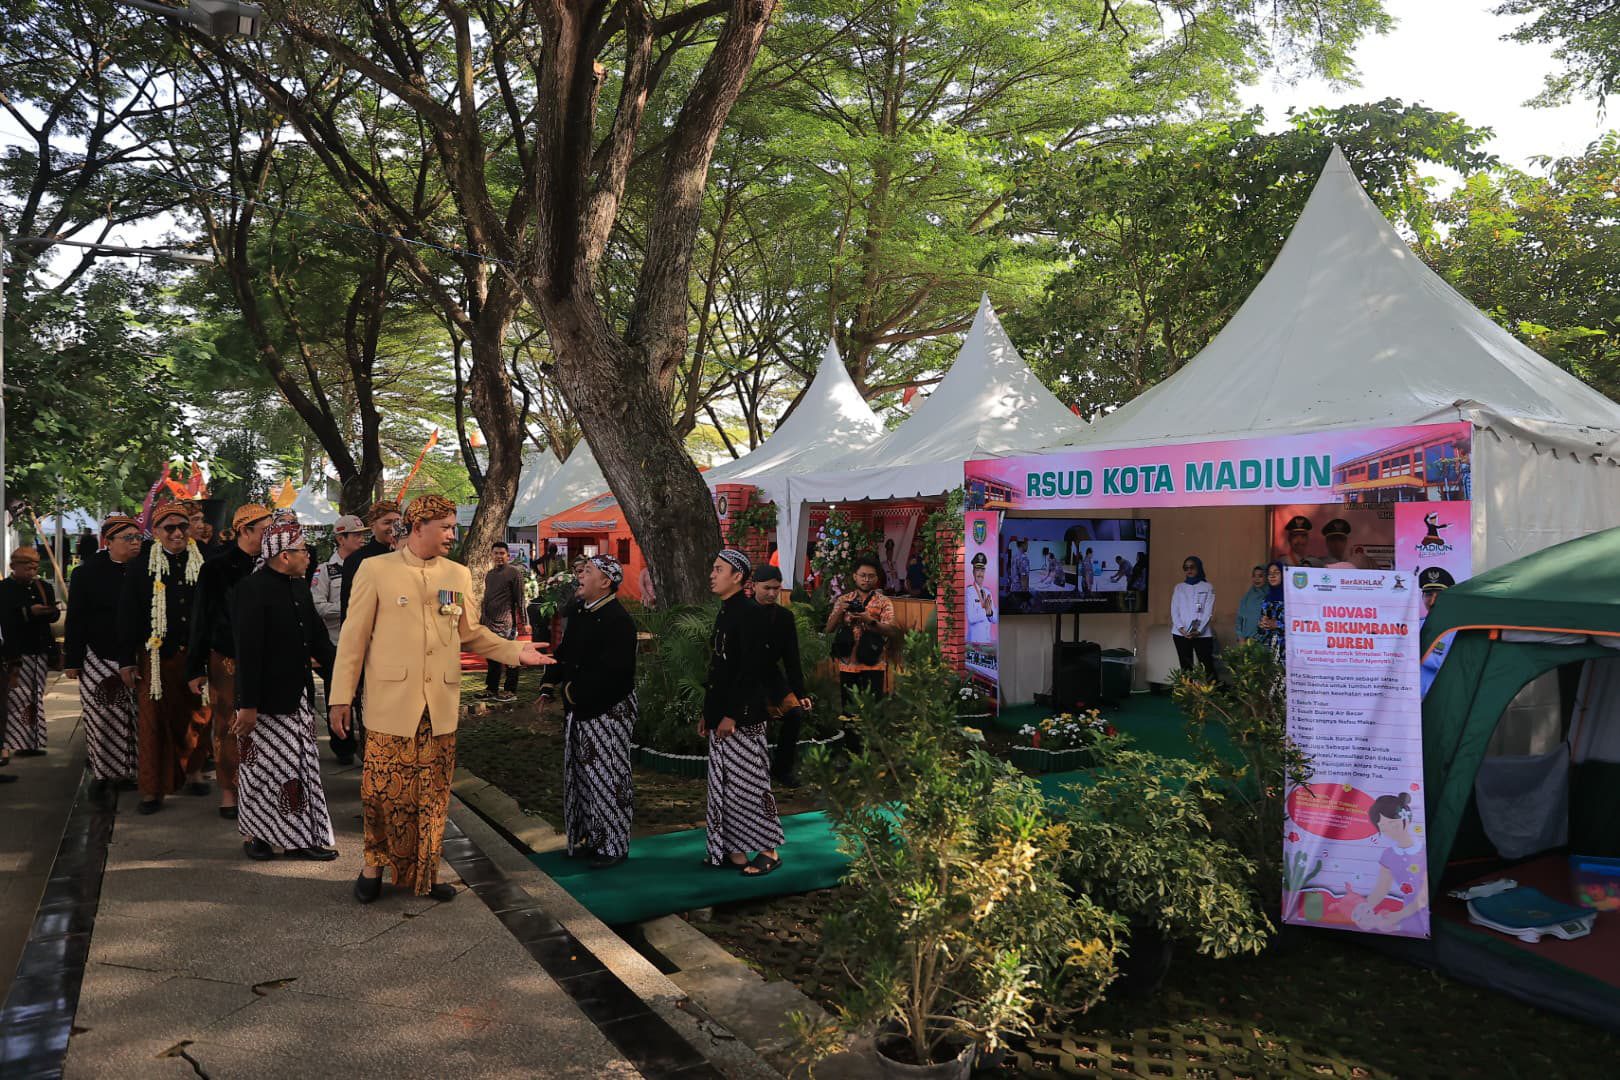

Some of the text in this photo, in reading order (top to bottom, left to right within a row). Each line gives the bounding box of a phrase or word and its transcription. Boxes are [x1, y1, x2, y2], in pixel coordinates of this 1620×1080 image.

[1027, 454, 1332, 499] RSUD KOTA MADIUN
[1415, 544, 1453, 552] MADIUN
[1322, 606, 1377, 619] INOVASI
[1292, 619, 1408, 636] PITA SIKUMBANG
[1327, 636, 1374, 649] DUREN
